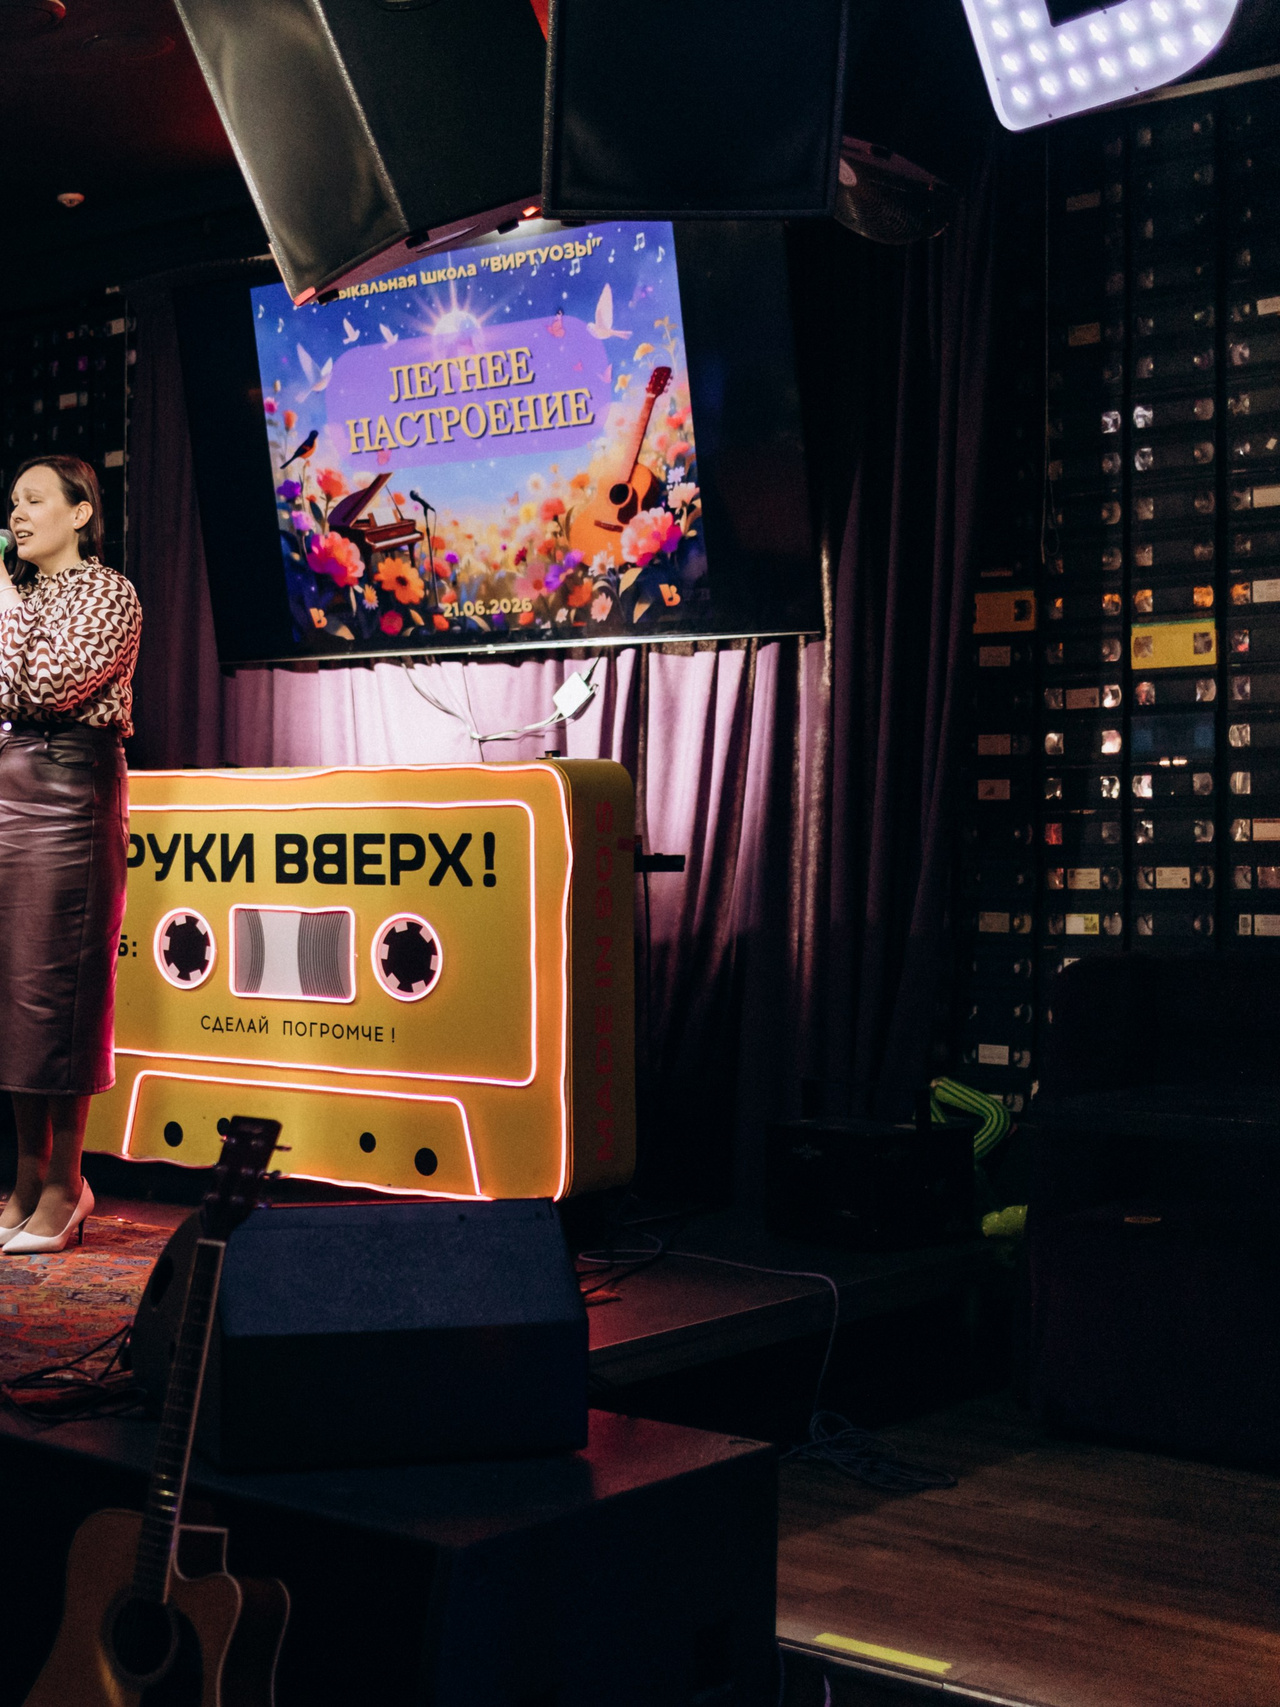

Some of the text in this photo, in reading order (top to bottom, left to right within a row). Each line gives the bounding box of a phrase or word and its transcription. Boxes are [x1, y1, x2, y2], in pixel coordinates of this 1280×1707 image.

[335, 237, 603, 301] ыкальная школа "ВИРТУОЗЫ"
[388, 347, 535, 402] ЛЕТНЕЕ
[346, 388, 594, 453] НАСТРОЕНИЕ
[443, 597, 533, 618] 21.06.2026
[126, 831, 497, 888] РУКИ ВВЕРХ!
[596, 801, 614, 1162] MADE IN 90'S
[200, 1015, 269, 1034] СДЕЛАЙ
